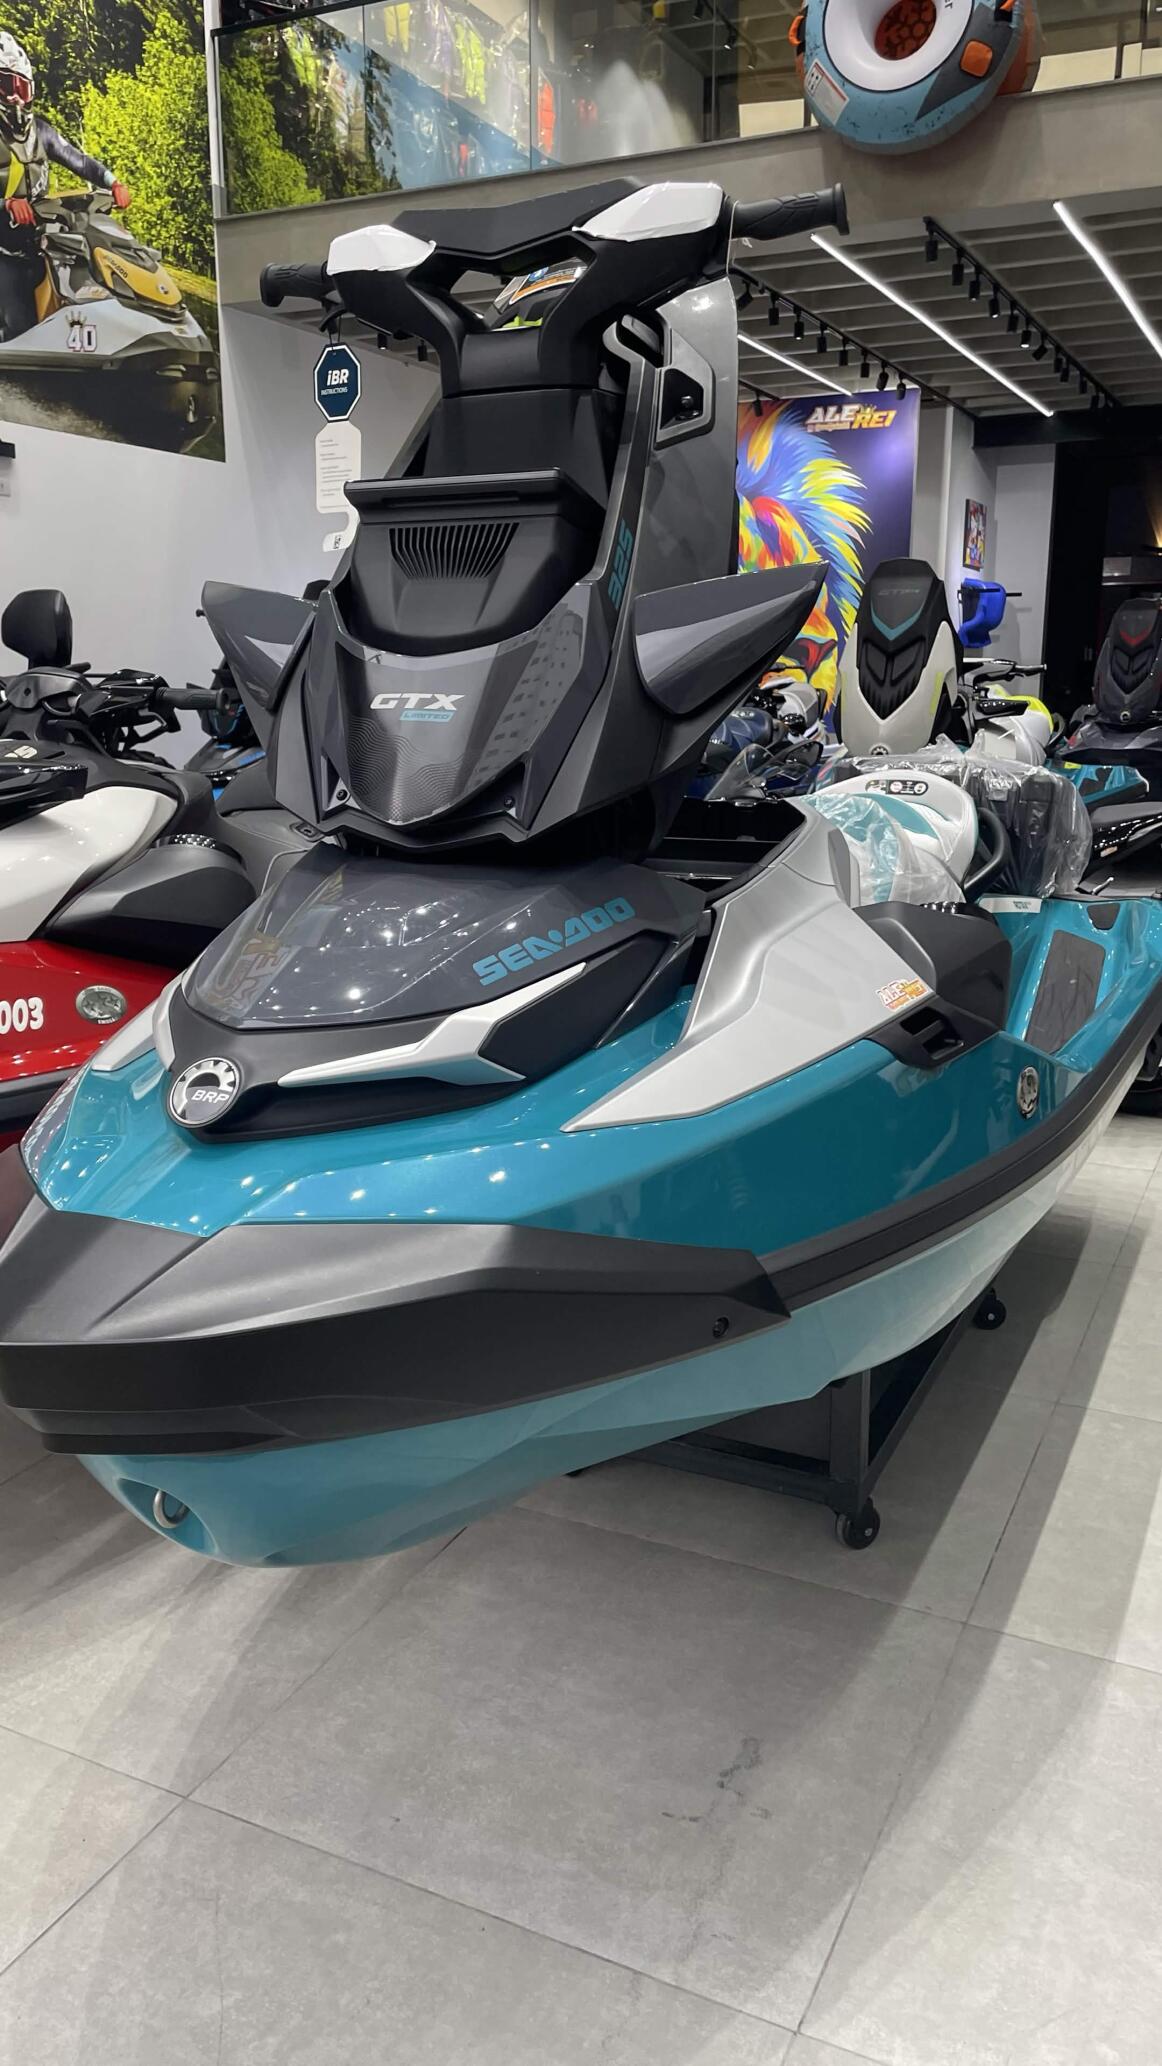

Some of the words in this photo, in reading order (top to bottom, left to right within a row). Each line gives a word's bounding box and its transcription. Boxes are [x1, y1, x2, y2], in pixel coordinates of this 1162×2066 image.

[67, 324, 97, 352] 40
[326, 368, 350, 387] iBR
[805, 403, 861, 424] ALE
[852, 409, 897, 429] REI
[607, 517, 634, 611] 325
[369, 692, 466, 711] GTX
[191, 1089, 230, 1104] BRP
